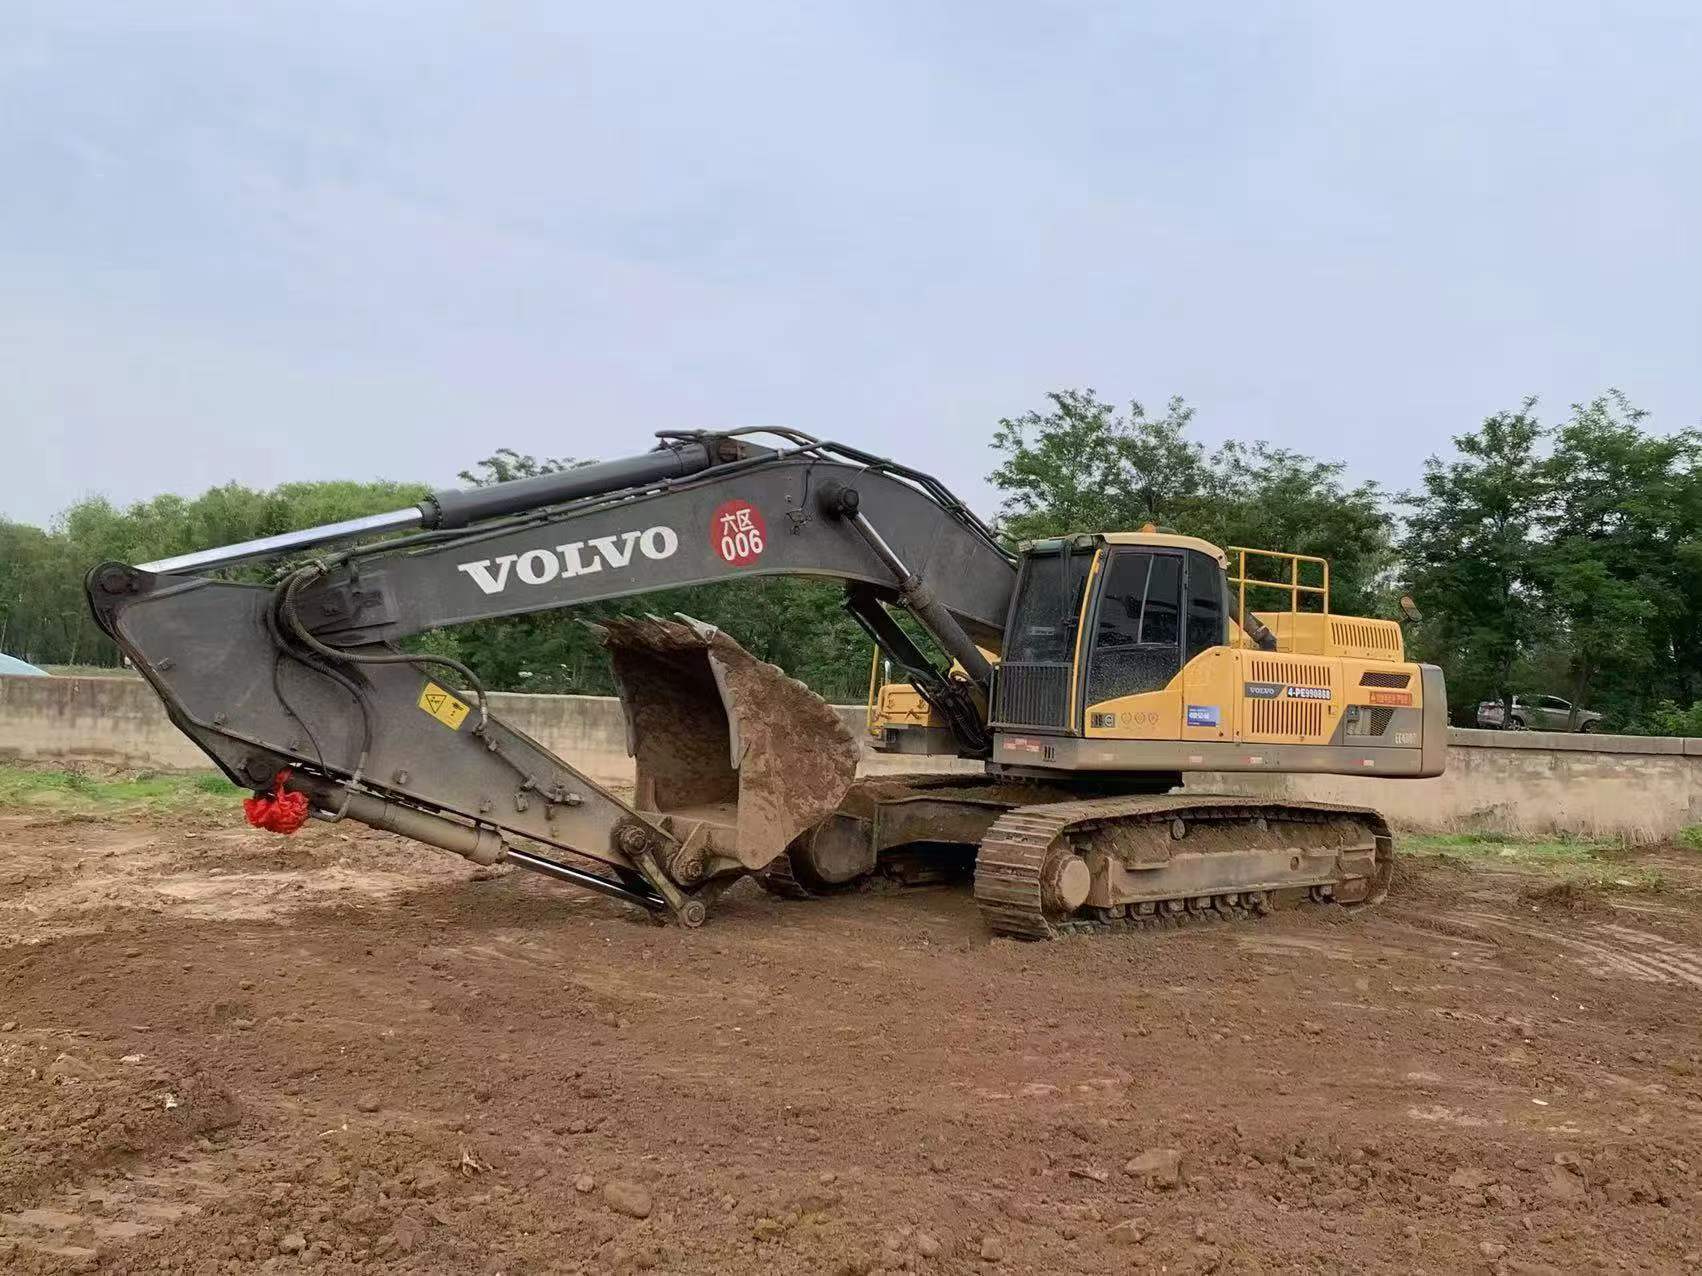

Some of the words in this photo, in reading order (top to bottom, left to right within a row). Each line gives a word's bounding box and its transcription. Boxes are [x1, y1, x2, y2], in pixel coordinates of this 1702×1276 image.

[720, 508, 755, 535] 六区
[720, 529, 764, 561] 006
[457, 525, 679, 595] VOLVO
[1248, 686, 1275, 695] VOLVO
